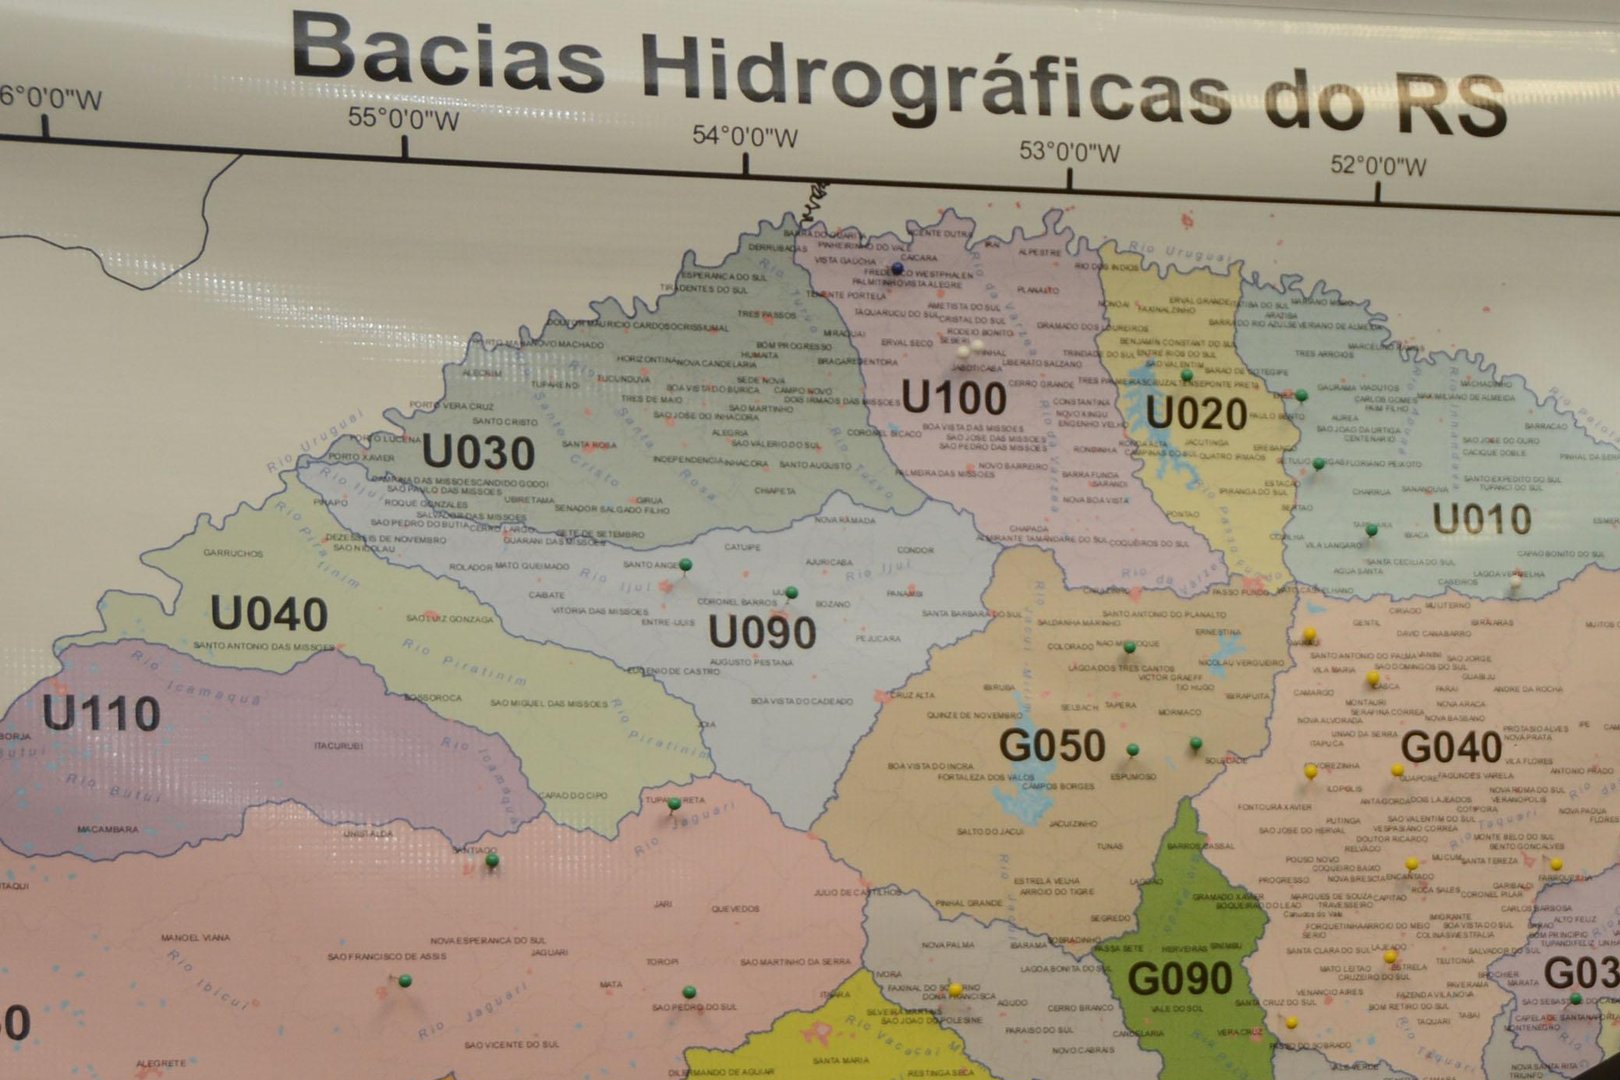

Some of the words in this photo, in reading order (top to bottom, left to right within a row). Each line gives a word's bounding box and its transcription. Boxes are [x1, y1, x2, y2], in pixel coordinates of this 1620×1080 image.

[292, 8, 606, 95] Bacias
[641, 32, 1233, 130] Hidrográficas
[1262, 67, 1366, 132] do
[1397, 71, 1508, 138] RS
[900, 378, 1006, 416] U100
[1146, 395, 1248, 431] U020
[422, 432, 536, 472] U030
[1433, 502, 1532, 535] U010
[210, 594, 329, 632] U040
[402, 637, 430, 656] Rio
[708, 612, 818, 650] U090
[130, 651, 160, 672] Rio
[43, 693, 161, 732] U110
[999, 728, 1106, 762] G050
[1401, 730, 1502, 764] G040
[167, 948, 194, 972] Rio
[1128, 961, 1233, 996] G090
[0, 1004, 31, 1041] 0
[417, 1021, 446, 1042] Rio
